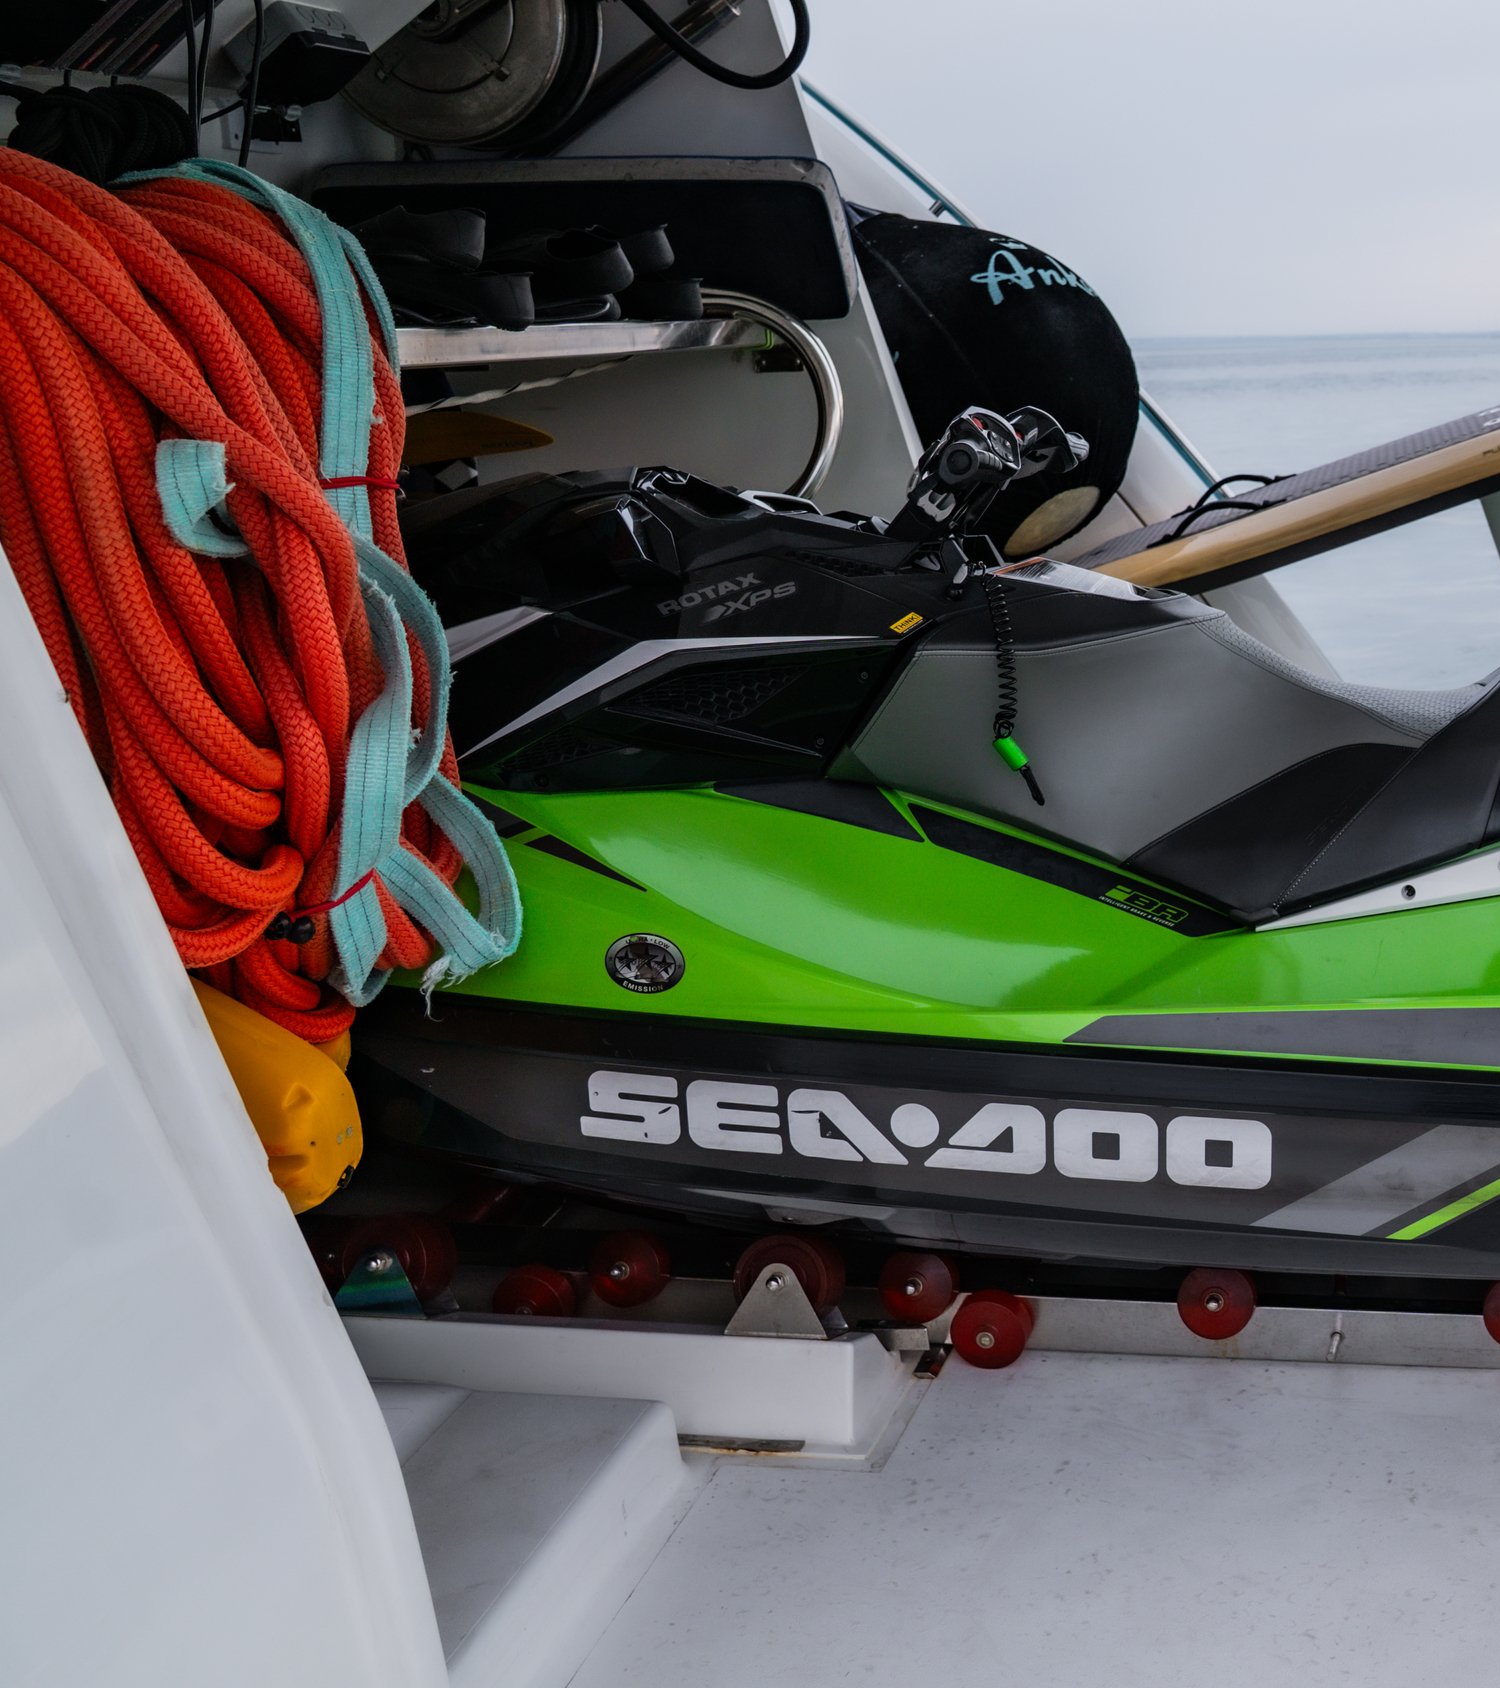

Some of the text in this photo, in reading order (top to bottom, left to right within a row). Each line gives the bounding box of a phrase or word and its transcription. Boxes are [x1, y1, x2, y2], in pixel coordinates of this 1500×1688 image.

[656, 572, 761, 616] ROTAX
[719, 581, 797, 618] XPS
[653, 938, 671, 949] LOW
[622, 980, 664, 992] EMISSION
